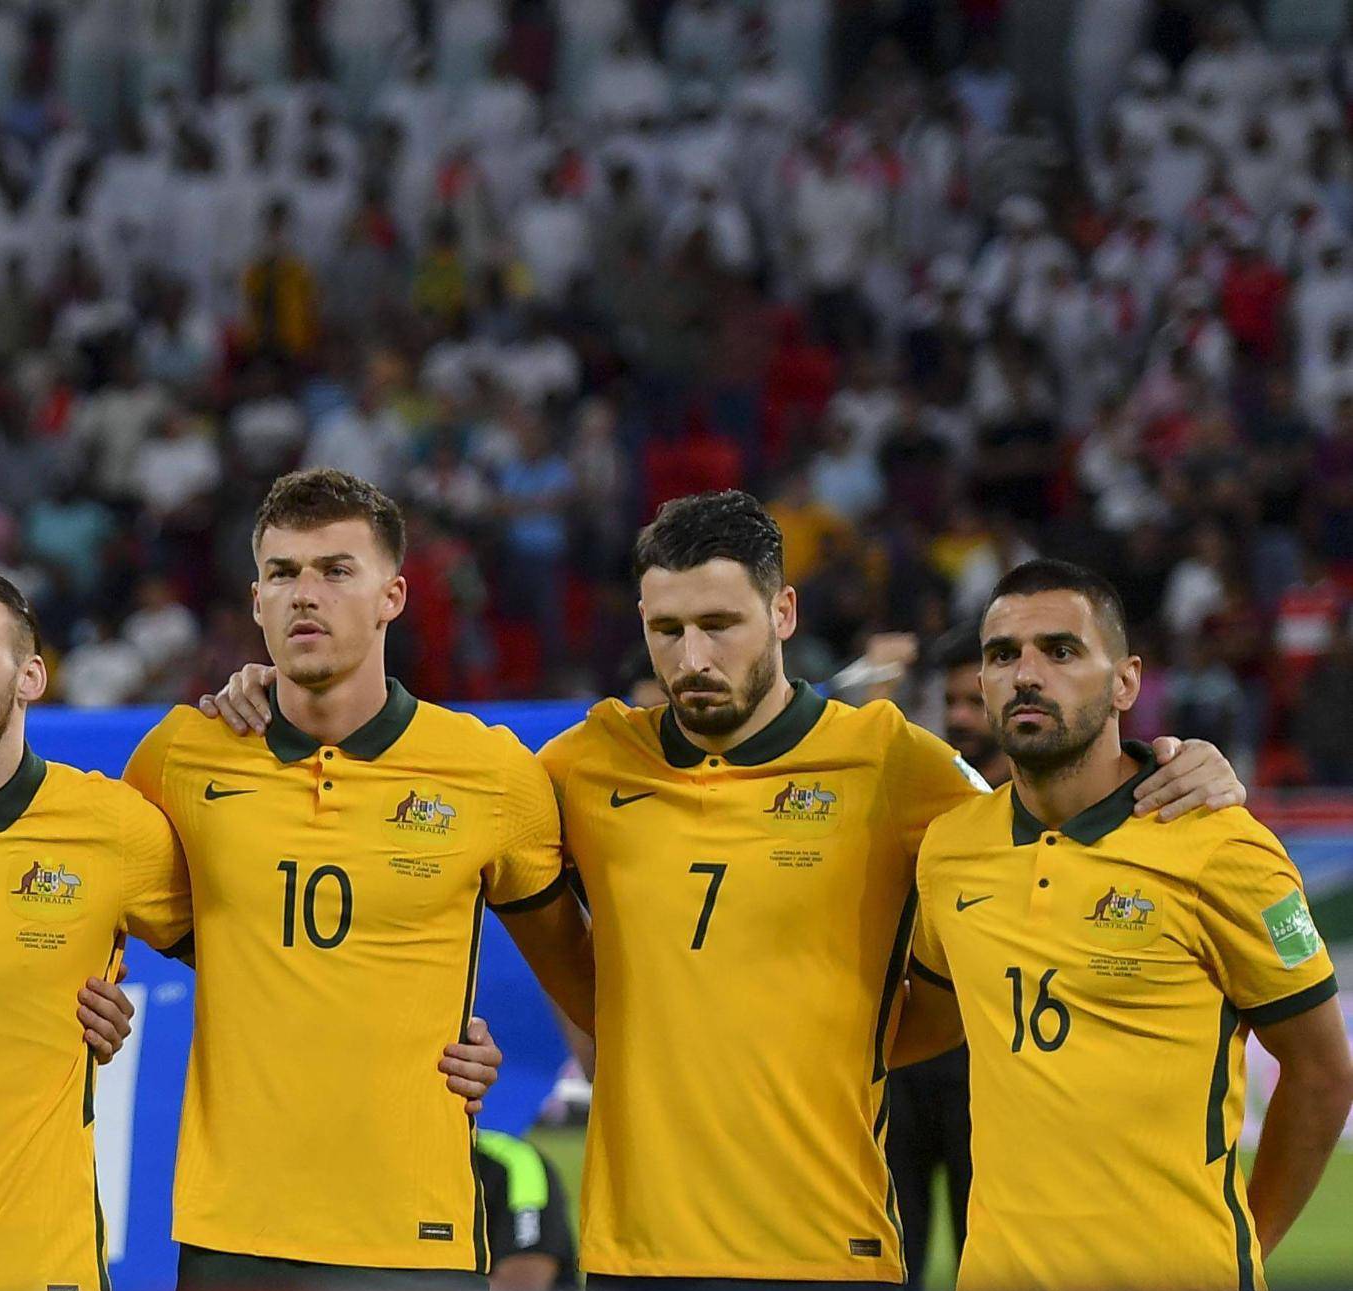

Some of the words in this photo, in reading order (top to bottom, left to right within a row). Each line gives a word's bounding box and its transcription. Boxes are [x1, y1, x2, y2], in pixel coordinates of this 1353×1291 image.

[396, 823, 447, 835] AUSTRALIA
[774, 812, 826, 821] AUSTRALIA
[21, 896, 72, 905] AUSTRALIA
[277, 860, 353, 949] 10
[689, 862, 728, 950] 7
[1005, 967, 1071, 1053] 16
